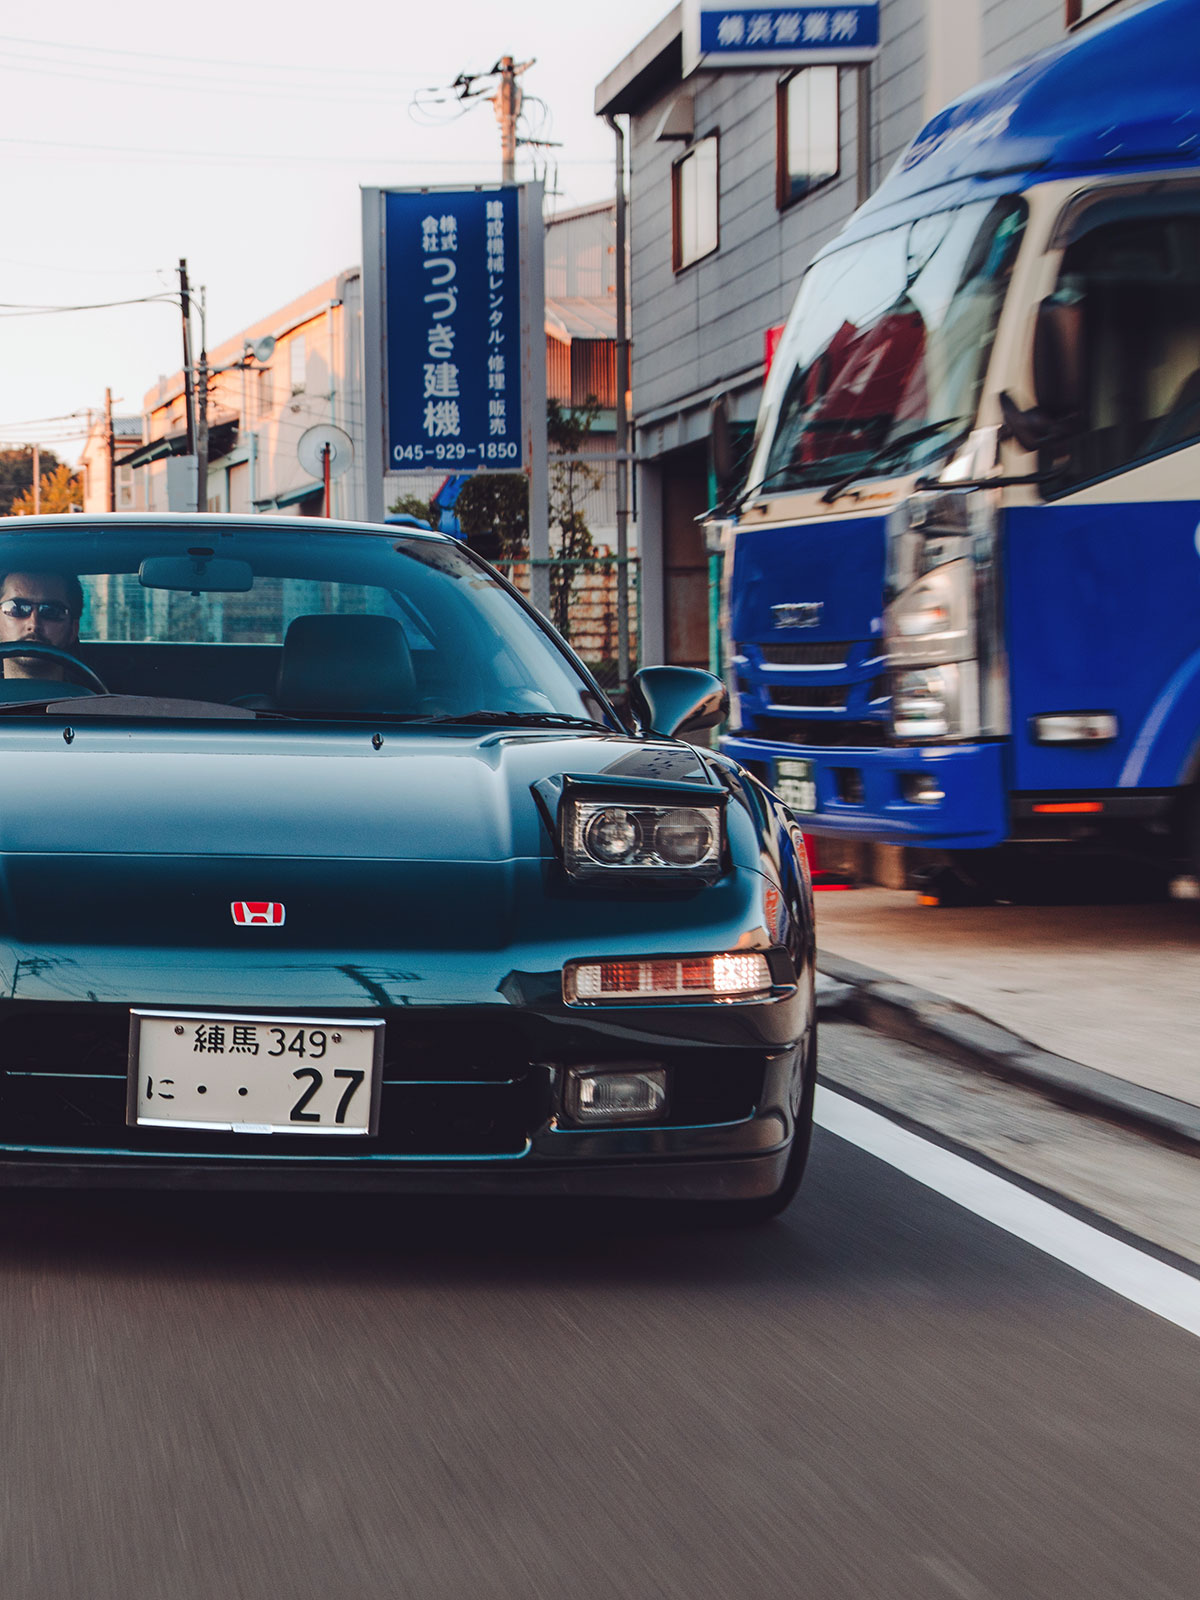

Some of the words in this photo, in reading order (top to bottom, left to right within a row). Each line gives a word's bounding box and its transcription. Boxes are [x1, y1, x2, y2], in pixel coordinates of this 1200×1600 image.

[486, 200, 506, 436] 建設機械レンタル・修理・販売
[423, 257, 461, 437] つづき建機
[394, 442, 518, 461] 045-929-1850
[193, 1024, 260, 1056] 練馬
[267, 1028, 327, 1058] 349
[290, 1067, 365, 1124] 27
